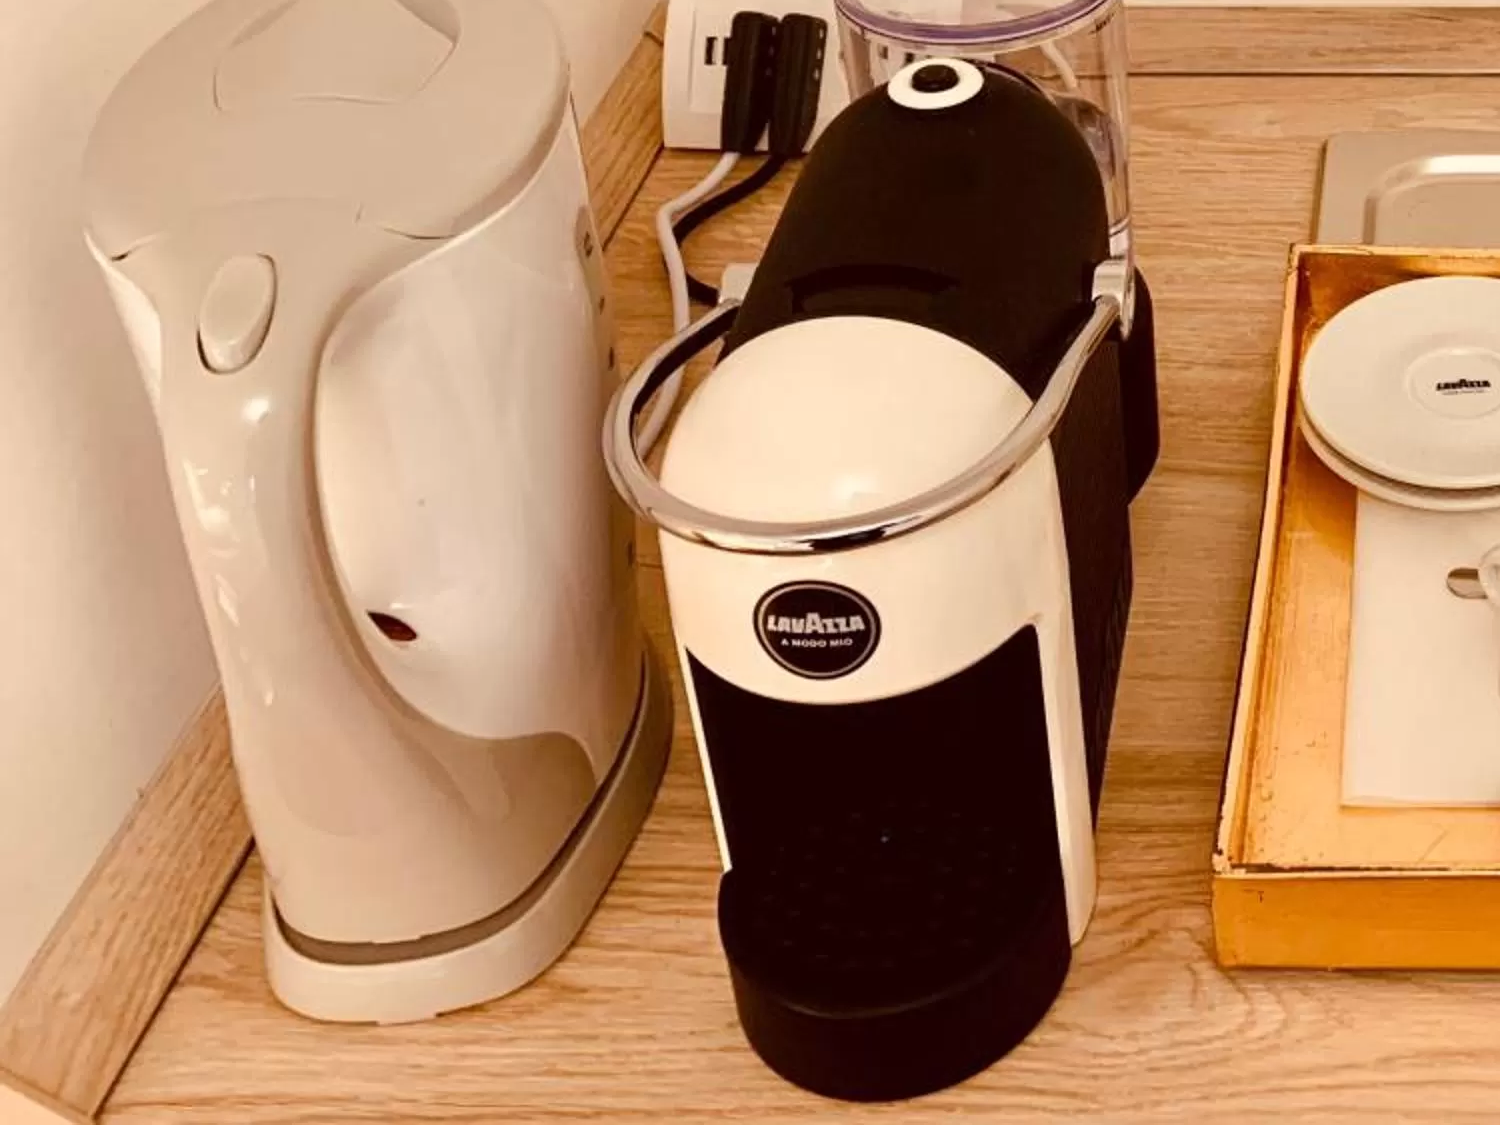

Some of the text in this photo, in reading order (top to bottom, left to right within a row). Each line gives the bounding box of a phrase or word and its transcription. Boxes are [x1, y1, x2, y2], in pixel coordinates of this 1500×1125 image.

[767, 612, 865, 634] LAVAZZA
[780, 637, 853, 648] A MODO MIO
